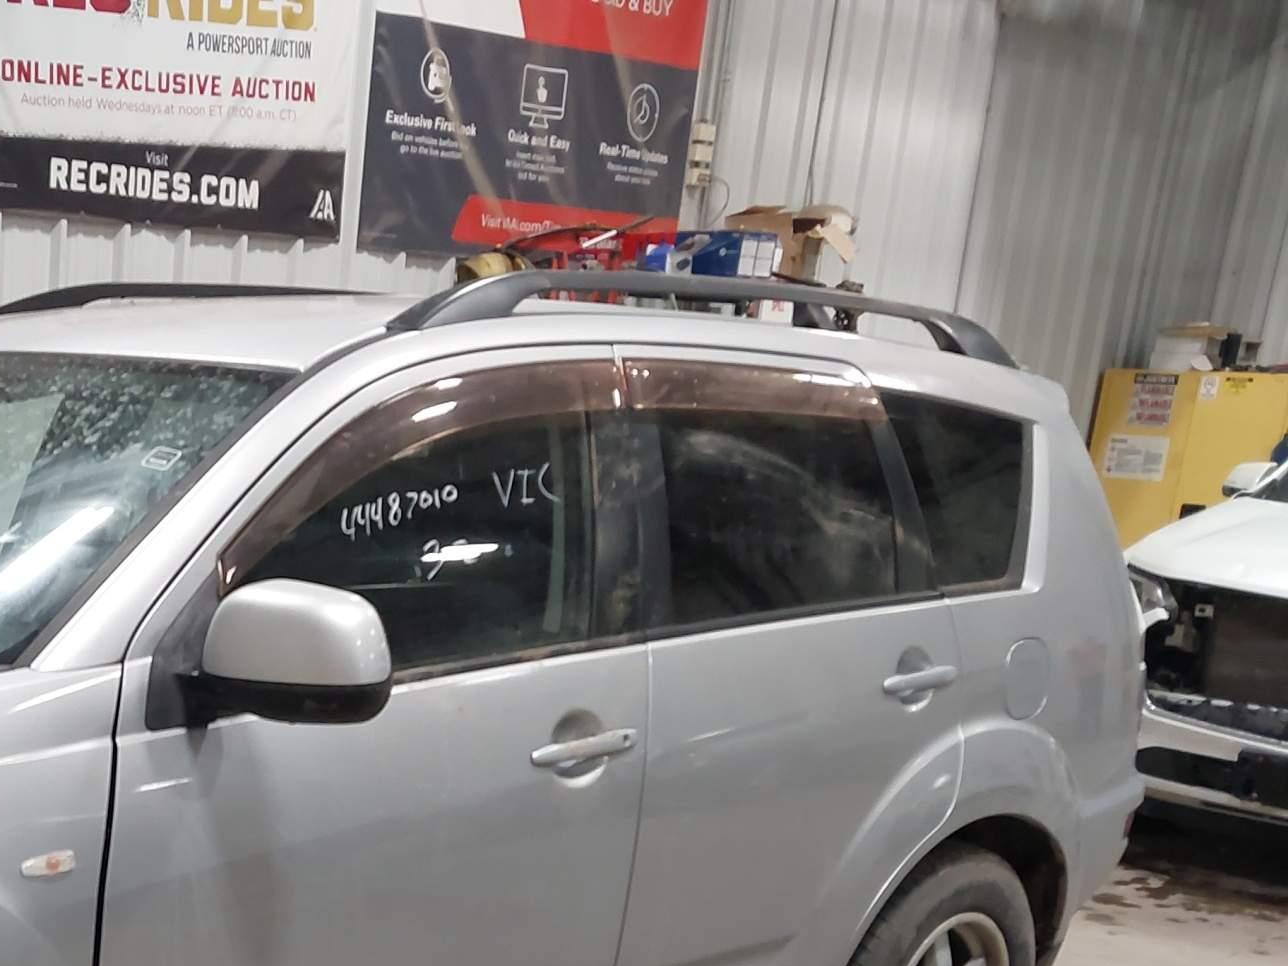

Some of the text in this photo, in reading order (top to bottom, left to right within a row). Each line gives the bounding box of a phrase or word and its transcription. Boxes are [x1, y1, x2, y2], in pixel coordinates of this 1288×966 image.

[186, 31, 312, 59] A POWERSPORT AUCTION
[1, 58, 316, 103] ONLINE-EXCLUSIVE AUCTION
[20, 93, 65, 107] Auction
[68, 95, 92, 109] held
[96, 98, 162, 115] Wednesdays
[164, 103, 175, 115] at
[178, 105, 206, 117] noon
[209, 104, 223, 117] ET
[385, 109, 432, 131] Exclusive
[508, 128, 529, 146] Quick
[550, 134, 570, 153] Easy
[145, 151, 169, 167] Visit
[49, 156, 260, 210] RECRIDES.COM
[340, 484, 459, 541] 44487010
